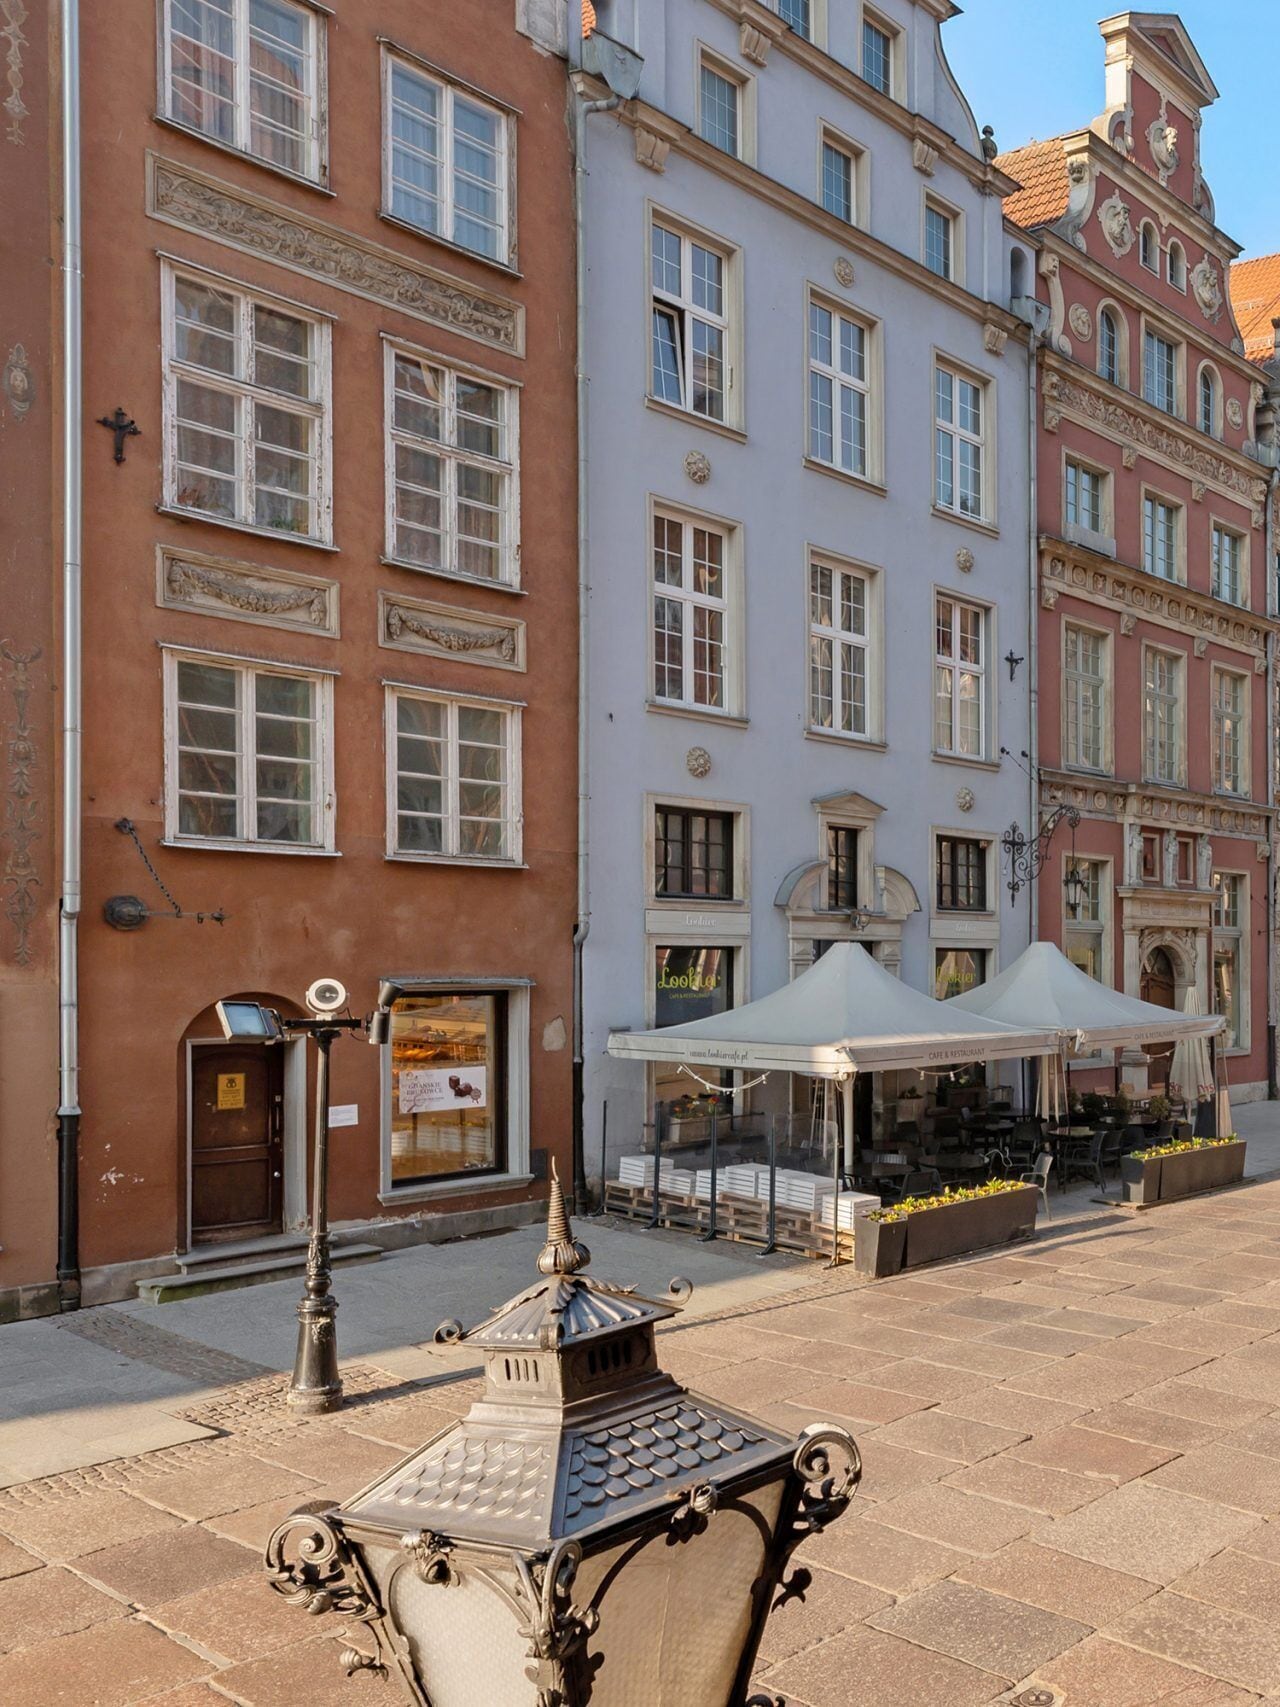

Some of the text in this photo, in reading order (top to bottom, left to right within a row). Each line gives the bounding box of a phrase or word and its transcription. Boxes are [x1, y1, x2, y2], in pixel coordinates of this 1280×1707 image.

[657, 966, 720, 989] Lookier
[928, 1048, 985, 1060] CAFE & RESTAURANT
